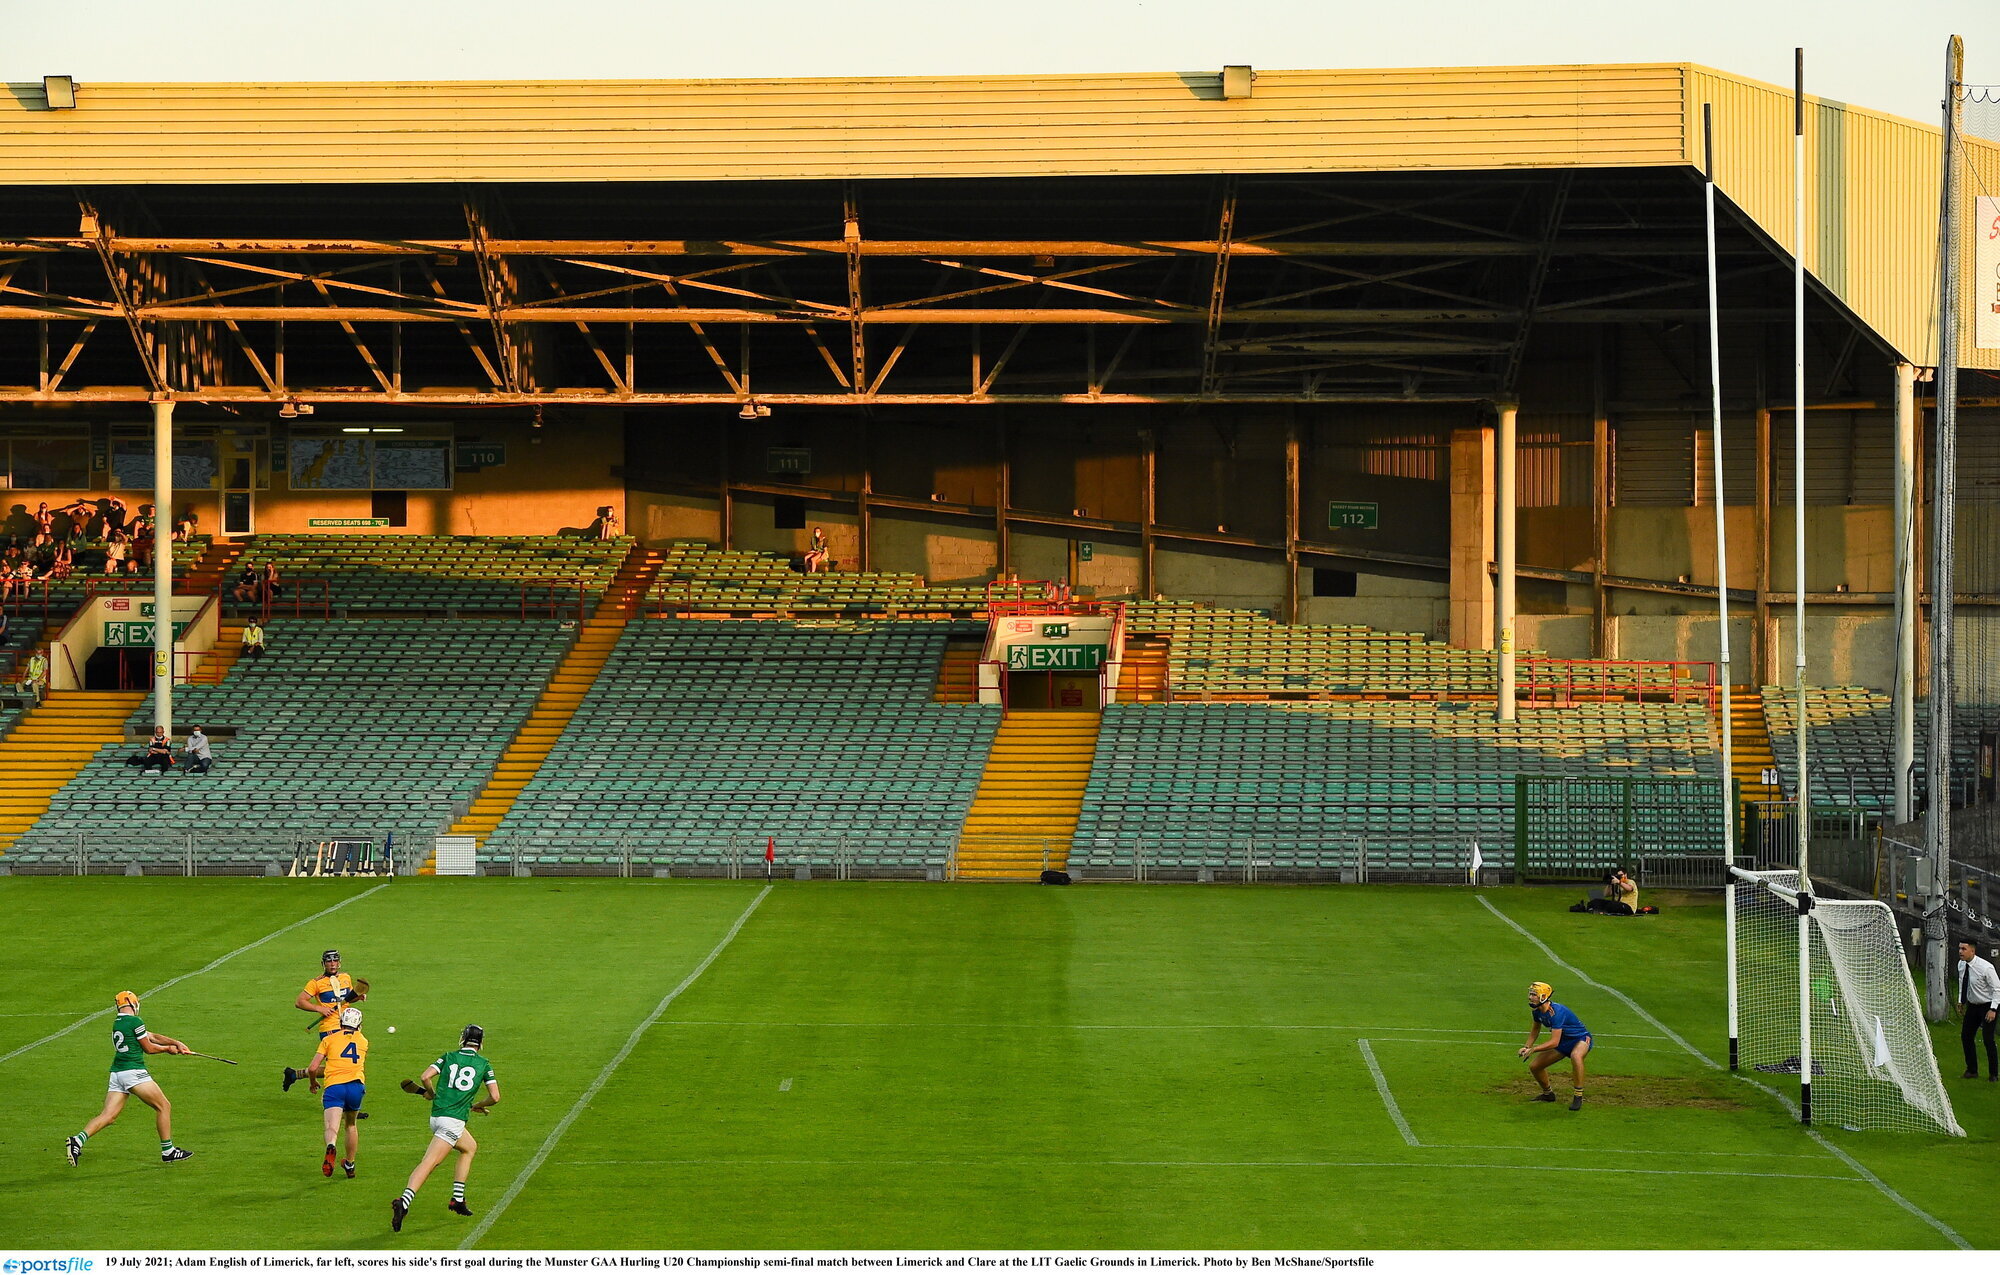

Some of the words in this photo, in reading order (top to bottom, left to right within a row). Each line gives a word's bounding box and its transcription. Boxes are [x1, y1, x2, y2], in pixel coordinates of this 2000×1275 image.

[95, 455, 105, 469] E
[472, 453, 495, 463] 110
[780, 458, 798, 469] 111
[1342, 513, 1365, 524] 112
[1032, 648, 1082, 666] EXIT
[1091, 648, 1100, 666] 1
[340, 1042, 360, 1064] 4
[448, 1063, 476, 1092] 18
